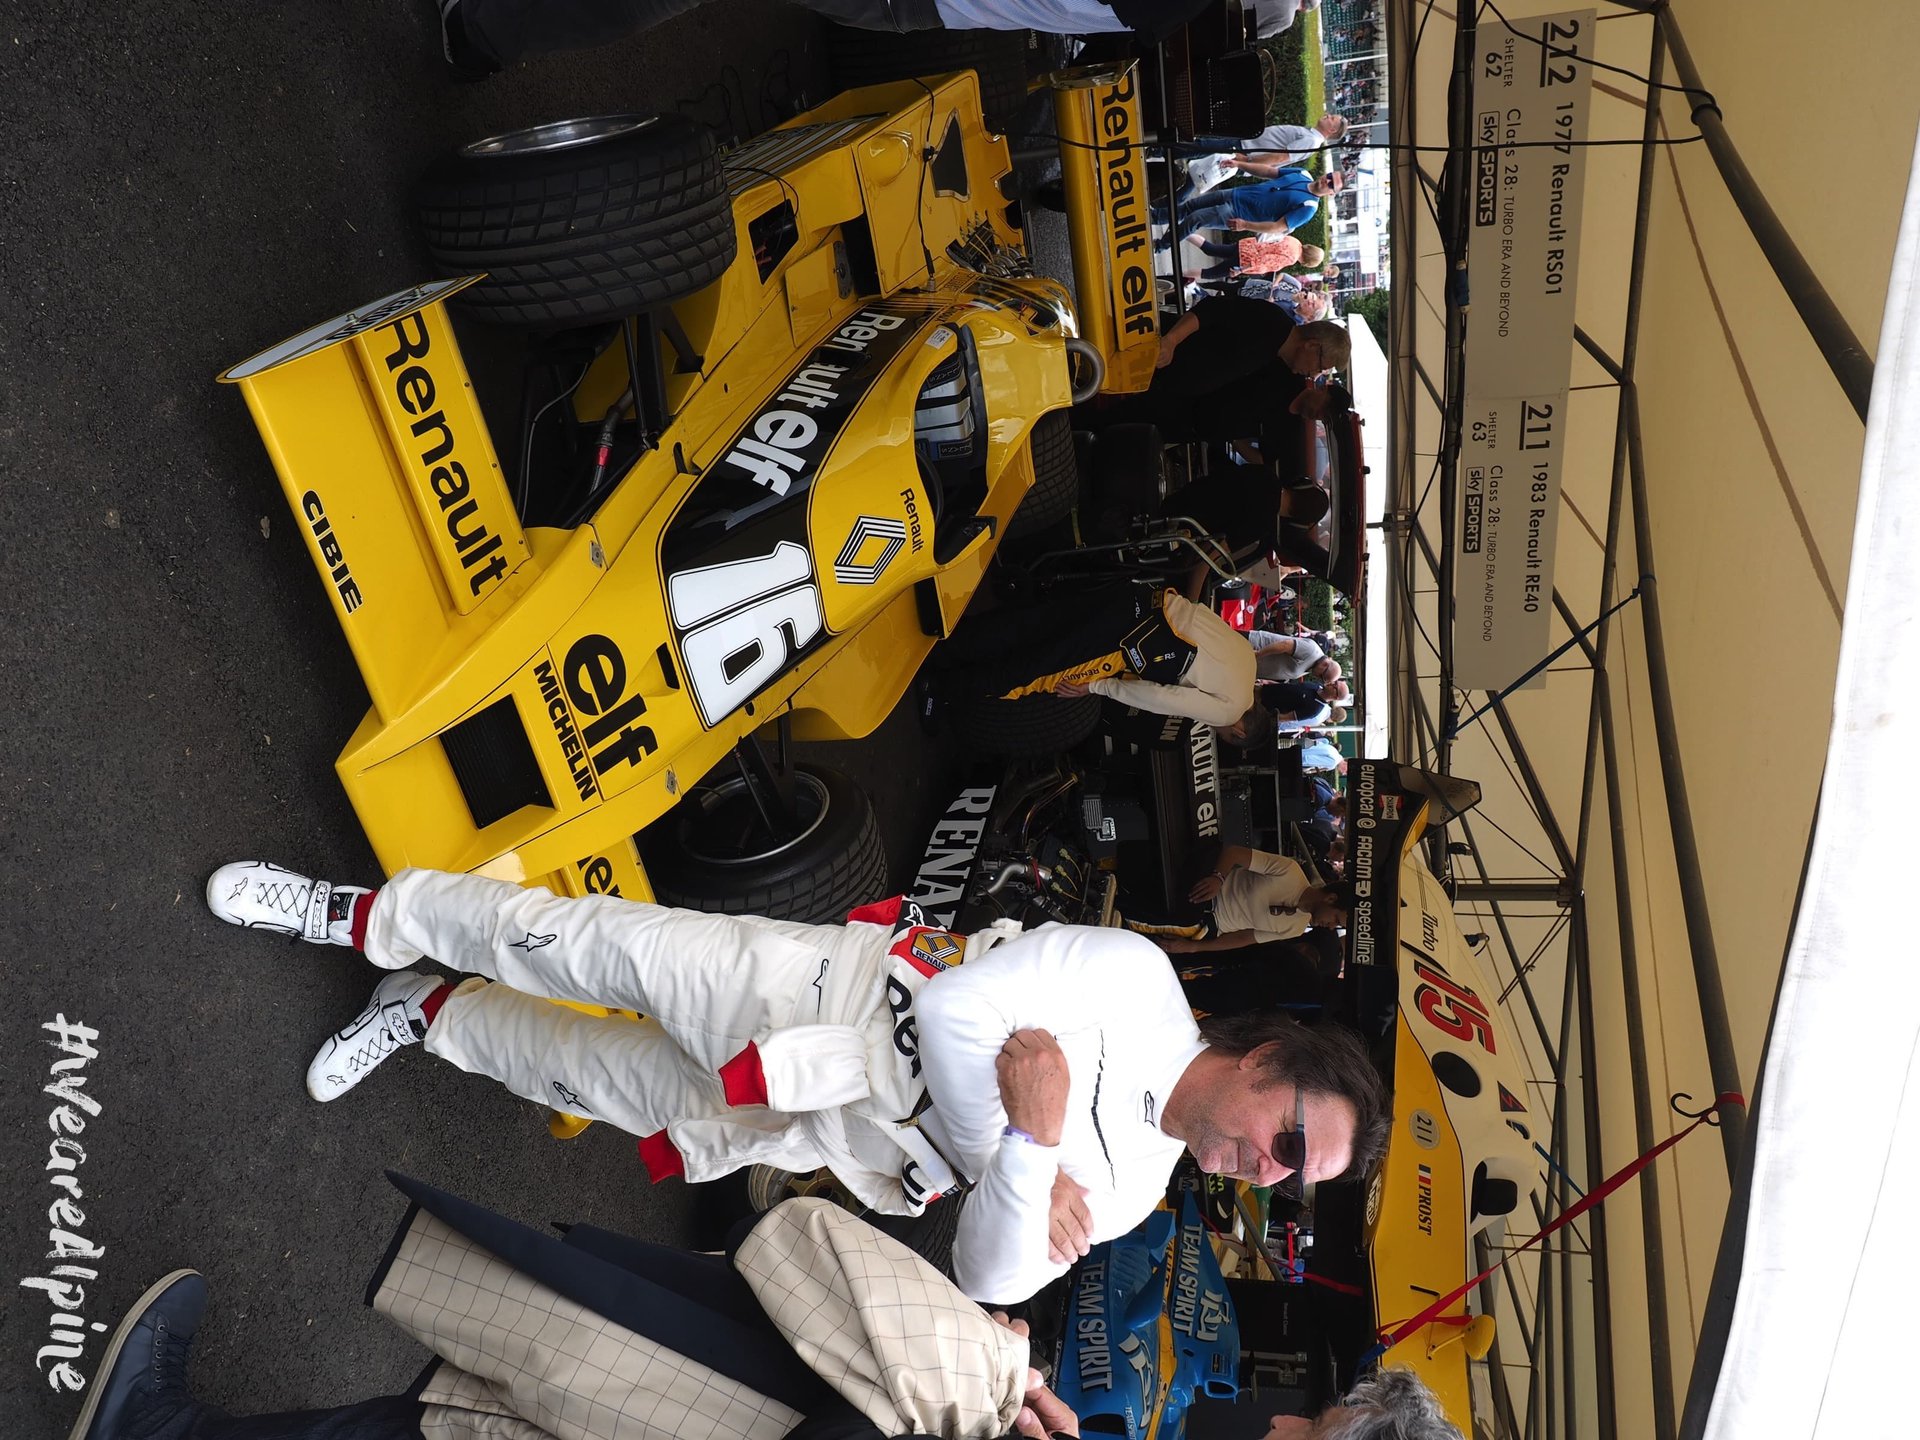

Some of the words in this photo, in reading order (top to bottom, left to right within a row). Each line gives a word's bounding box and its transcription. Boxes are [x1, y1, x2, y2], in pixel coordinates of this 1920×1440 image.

[1485, 52, 1502, 78] 62
[1502, 38, 1515, 87] SHELTER
[1547, 20, 1579, 87] 212
[1481, 116, 1498, 144] sky
[1504, 108, 1521, 157] Class
[1553, 102, 1574, 155] 1977
[1102, 75, 1148, 258] Renault
[1479, 152, 1495, 223] SPORTS
[1504, 164, 1518, 191] 28:
[1502, 196, 1514, 235] TURBO
[1547, 165, 1570, 241] Renault
[1501, 239, 1513, 259] ERA
[1500, 261, 1512, 288] AND
[1545, 250, 1564, 295] RS01
[1121, 266, 1154, 335] elf
[1498, 294, 1511, 337] BEYOND
[1472, 421, 1487, 442] 63
[1487, 411, 1497, 449] SHELTER
[1525, 404, 1552, 450] 211
[374, 310, 508, 597] Renault
[725, 410, 818, 497] elf
[1467, 470, 1483, 491] sky
[1488, 465, 1503, 502] Class
[1530, 462, 1549, 503] 1983
[899, 488, 925, 555] Renault
[1465, 497, 1479, 551] SPORTS
[1487, 507, 1500, 528] 28:
[1526, 509, 1545, 569] Renault
[1486, 531, 1497, 562] TURBO
[1484, 582, 1495, 602] AND
[1485, 564, 1496, 581] ERA
[1524, 574, 1540, 613] RE40
[667, 539, 823, 728] 16
[1482, 605, 1494, 642] BEYOND
[563, 634, 658, 777] elf
[533, 659, 597, 802] MICHELIN
[1356, 764, 1376, 817] europcar
[1385, 797, 1395, 819] CHAMPION
[1196, 803, 1219, 838] elf
[1356, 836, 1373, 879] FACOM
[1354, 901, 1375, 964] speedline
[1422, 910, 1438, 951] Turbo
[1413, 960, 1496, 1055] 15
[1416, 1115, 1432, 1142] 211
[1418, 1184, 1432, 1236] PROST
[1179, 1223, 1203, 1271] TEAM
[1077, 1260, 1106, 1315] TEAM
[1173, 1273, 1196, 1336] SPIRIT
[1077, 1318, 1113, 1391] SPIRIT
